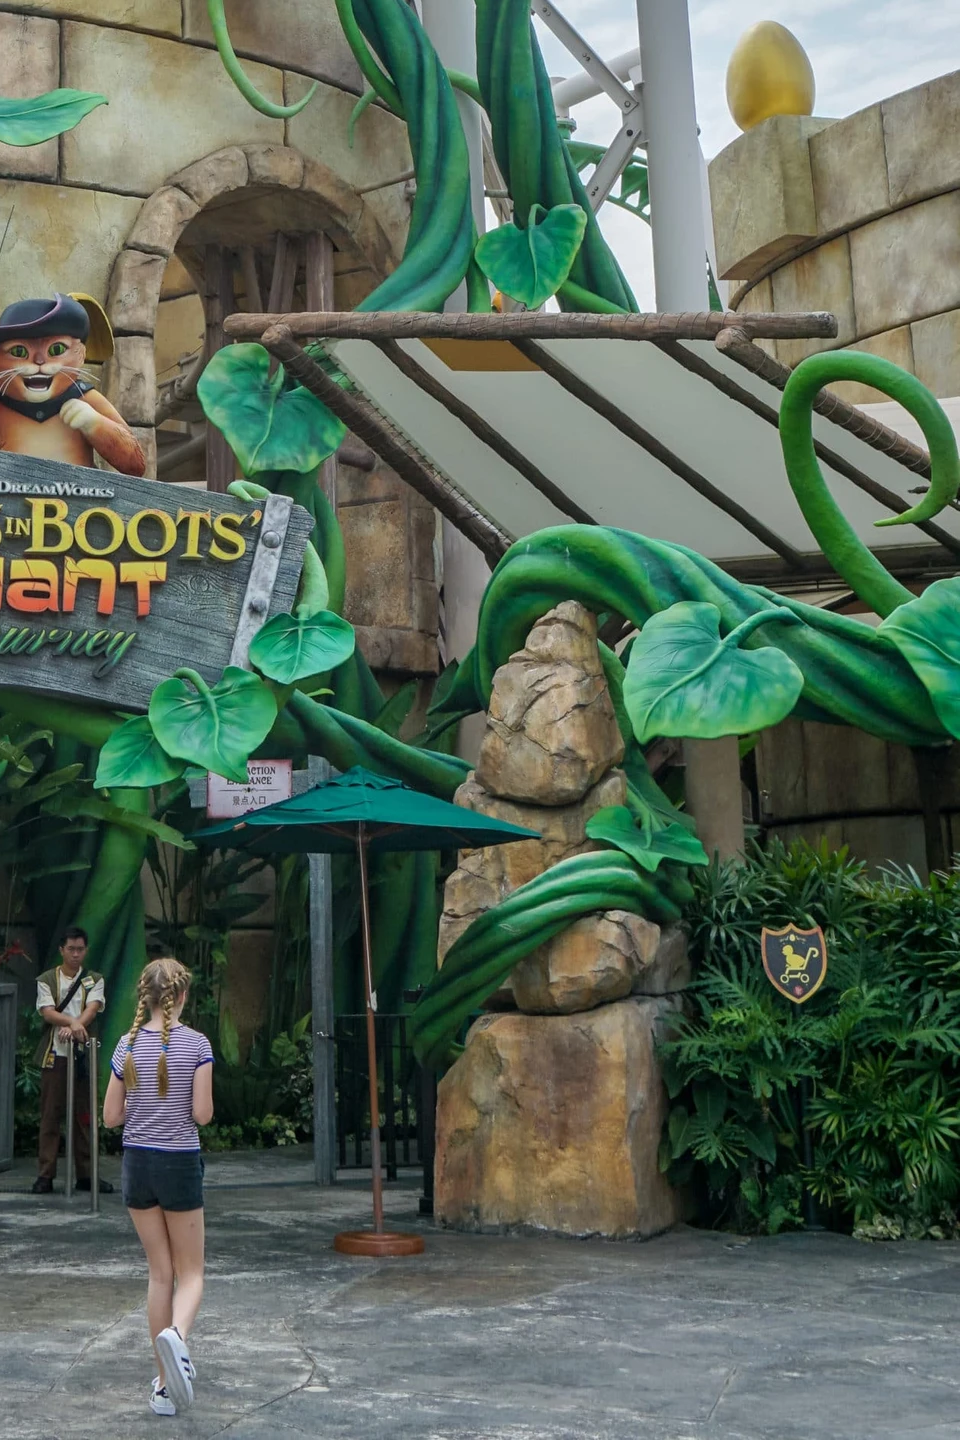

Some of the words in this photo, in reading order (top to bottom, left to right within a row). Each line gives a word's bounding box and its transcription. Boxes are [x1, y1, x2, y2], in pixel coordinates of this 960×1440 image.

[4, 515, 32, 537] IN
[24, 497, 263, 562] BOOTS'
[232, 795, 267, 806] 景点入口
